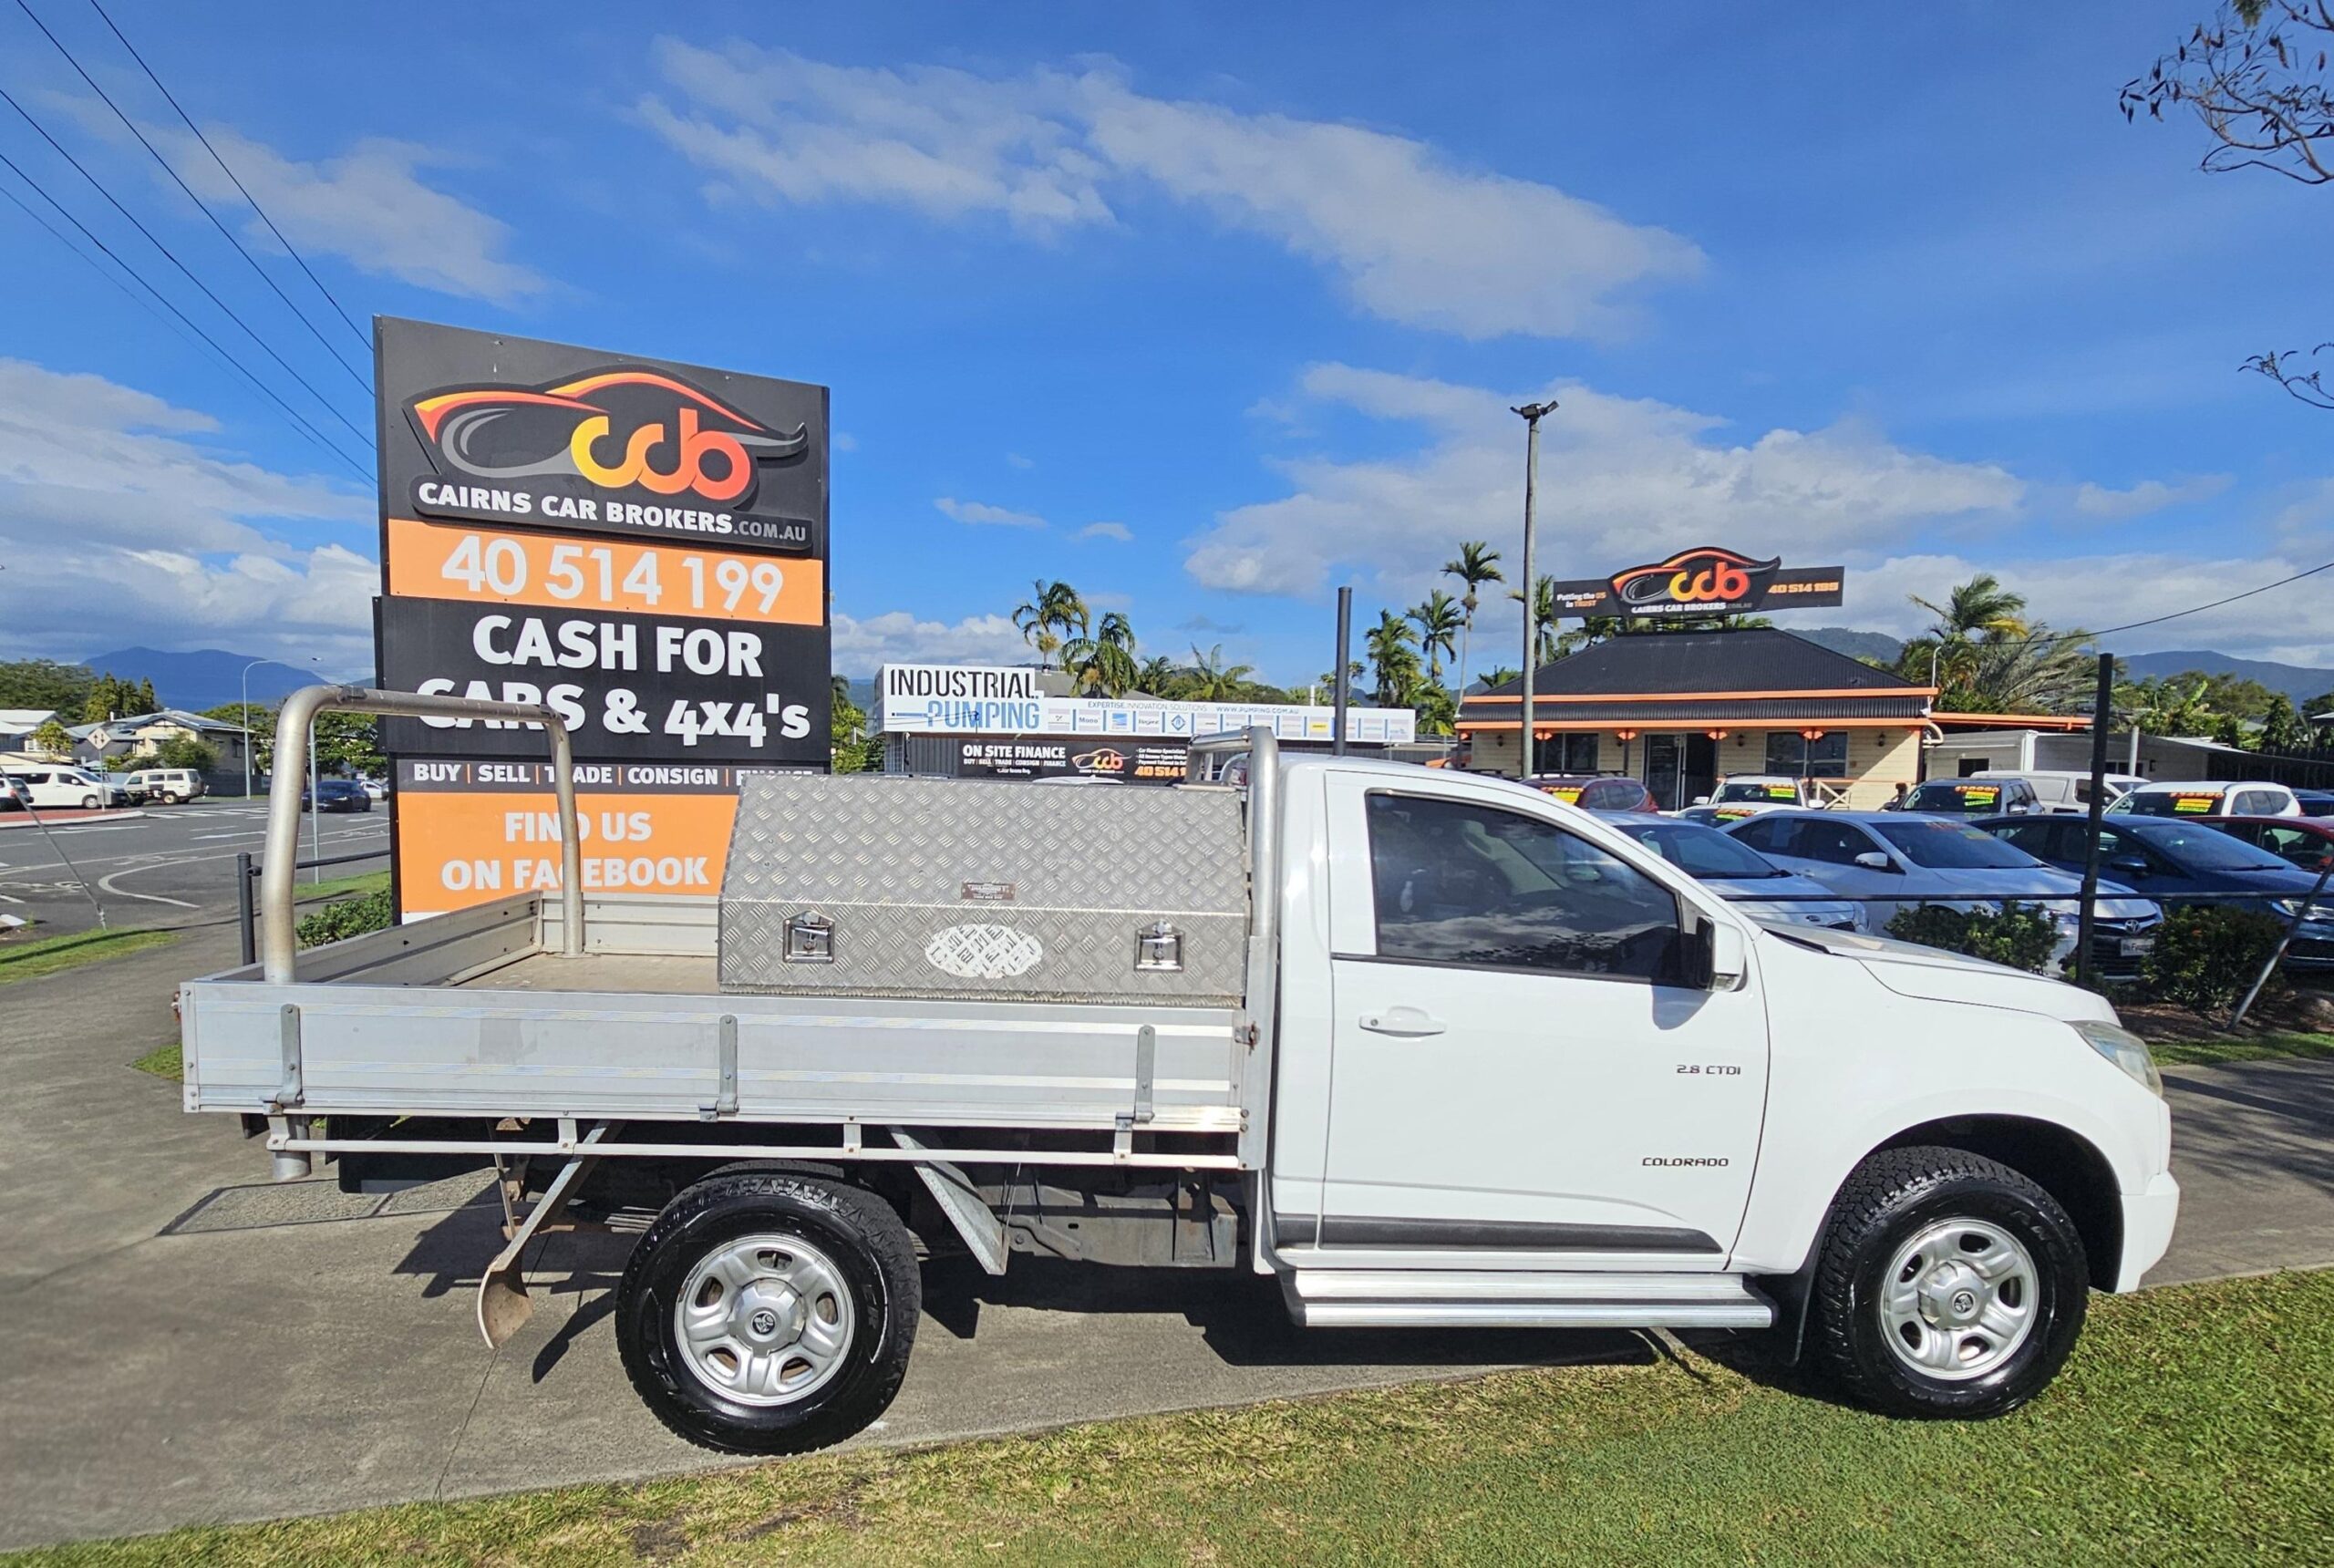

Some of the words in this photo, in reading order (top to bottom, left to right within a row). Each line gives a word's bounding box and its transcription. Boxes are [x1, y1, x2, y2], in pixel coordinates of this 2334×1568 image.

[418, 482, 532, 513] CAIRNS
[541, 495, 598, 521] CAR
[441, 536, 527, 596] 40
[545, 545, 663, 605] 514
[682, 557, 784, 614] 199
[1768, 584, 1788, 593] 40
[1789, 583, 1812, 593] 514
[1665, 603, 1683, 612] CAR
[473, 615, 636, 671] CASH
[656, 626, 763, 677] FOR
[890, 668, 1035, 699] INDUSTRIAL
[604, 689, 650, 734] &
[927, 700, 1040, 729] PUMPING
[963, 744, 983, 757] ON
[985, 745, 1013, 758] SITE
[1015, 747, 1066, 758] FINANCE
[414, 764, 461, 782] BUY
[478, 765, 530, 784] SELL
[544, 766, 613, 784] TADE
[627, 767, 718, 786] CONSIGN
[1135, 766, 1154, 776] 40
[1154, 767, 1180, 777] 514
[602, 812, 652, 841] US
[441, 860, 501, 891] ON
[513, 857, 709, 890] FAEBOOK
[1706, 1065, 1741, 1076] CTDI
[1642, 1157, 1730, 1167] COLORADO
